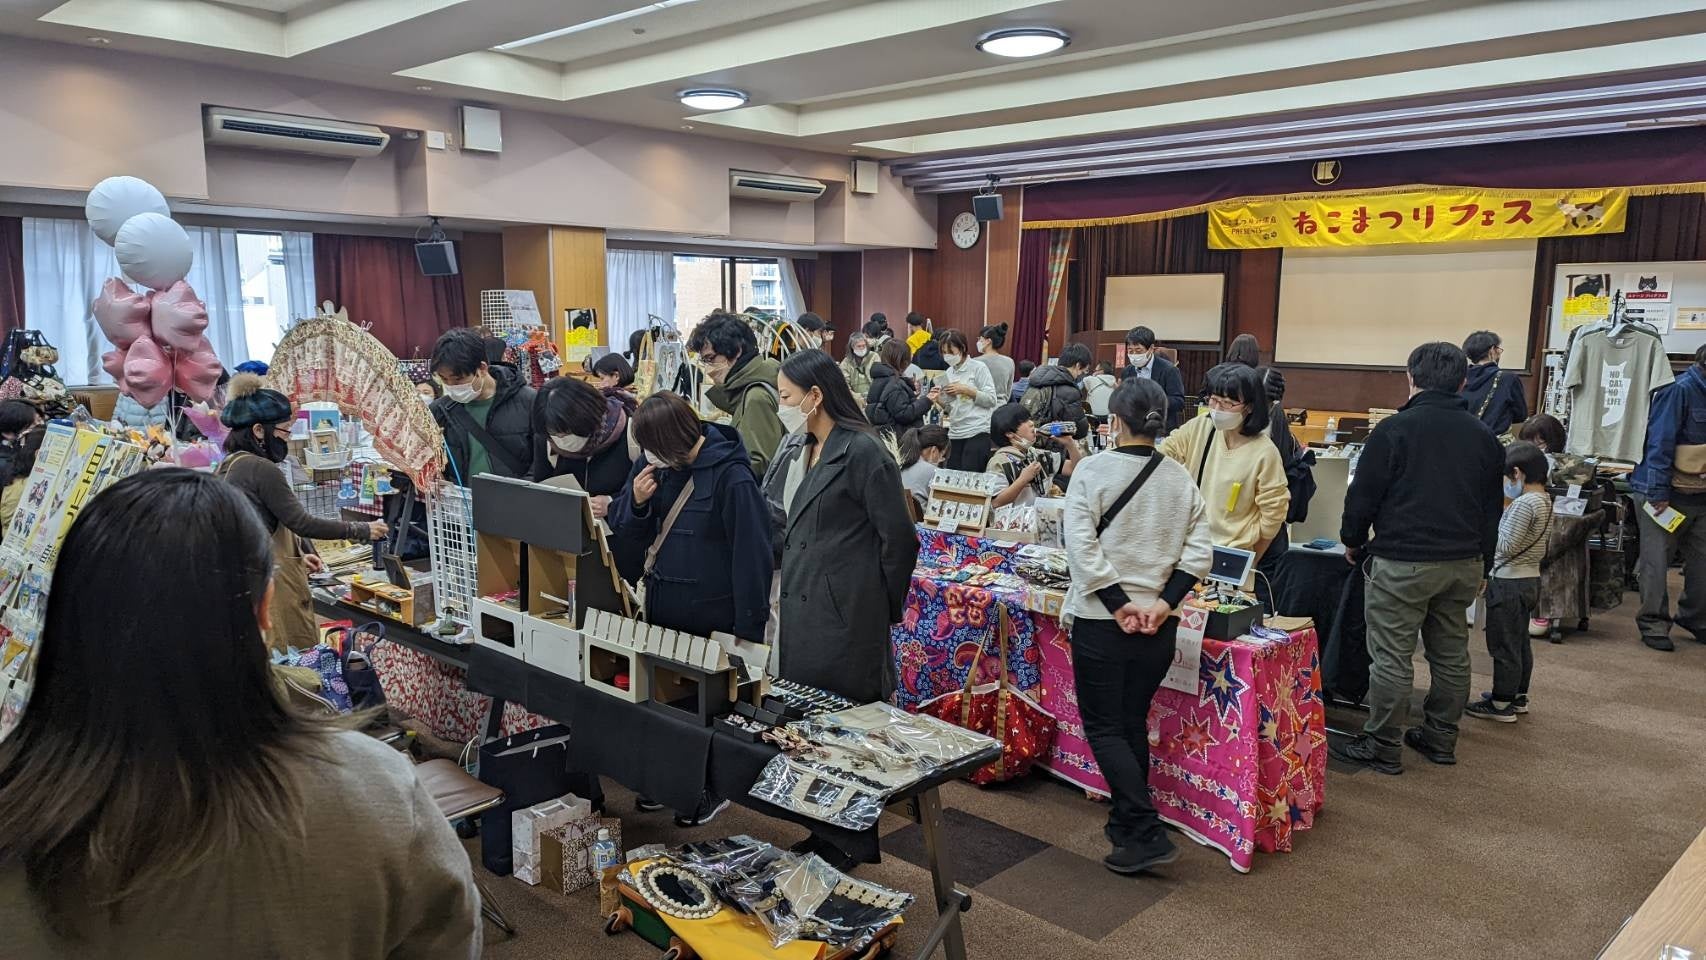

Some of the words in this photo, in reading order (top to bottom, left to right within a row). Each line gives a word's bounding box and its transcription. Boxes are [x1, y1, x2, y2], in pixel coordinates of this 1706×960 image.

[1292, 200, 1534, 235] ねこまつりフェス
[1609, 370, 1620, 378] NO
[1609, 379, 1623, 387] CAT
